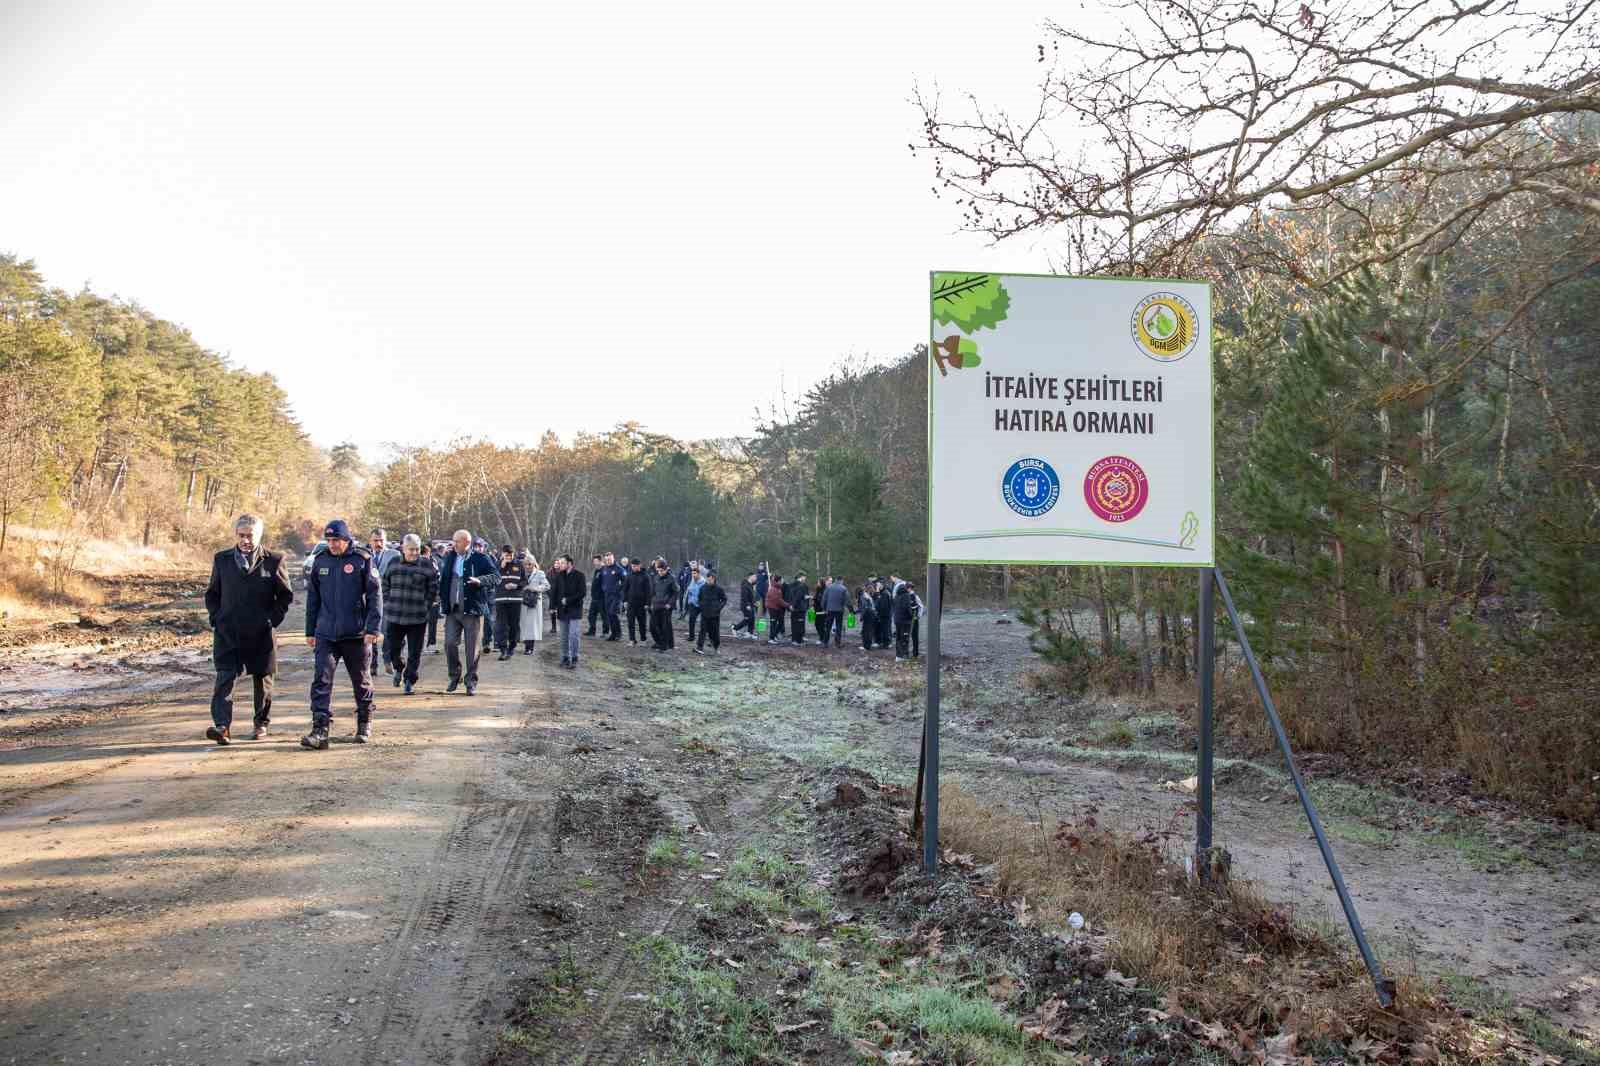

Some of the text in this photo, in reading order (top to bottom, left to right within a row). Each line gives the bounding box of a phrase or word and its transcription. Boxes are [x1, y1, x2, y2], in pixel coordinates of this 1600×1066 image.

[985, 371, 1163, 406] İTFAİYE ŞEHİTLERİ
[994, 408, 1154, 435] HATIRA ORMANI
[1018, 459, 1045, 469] BURSA
